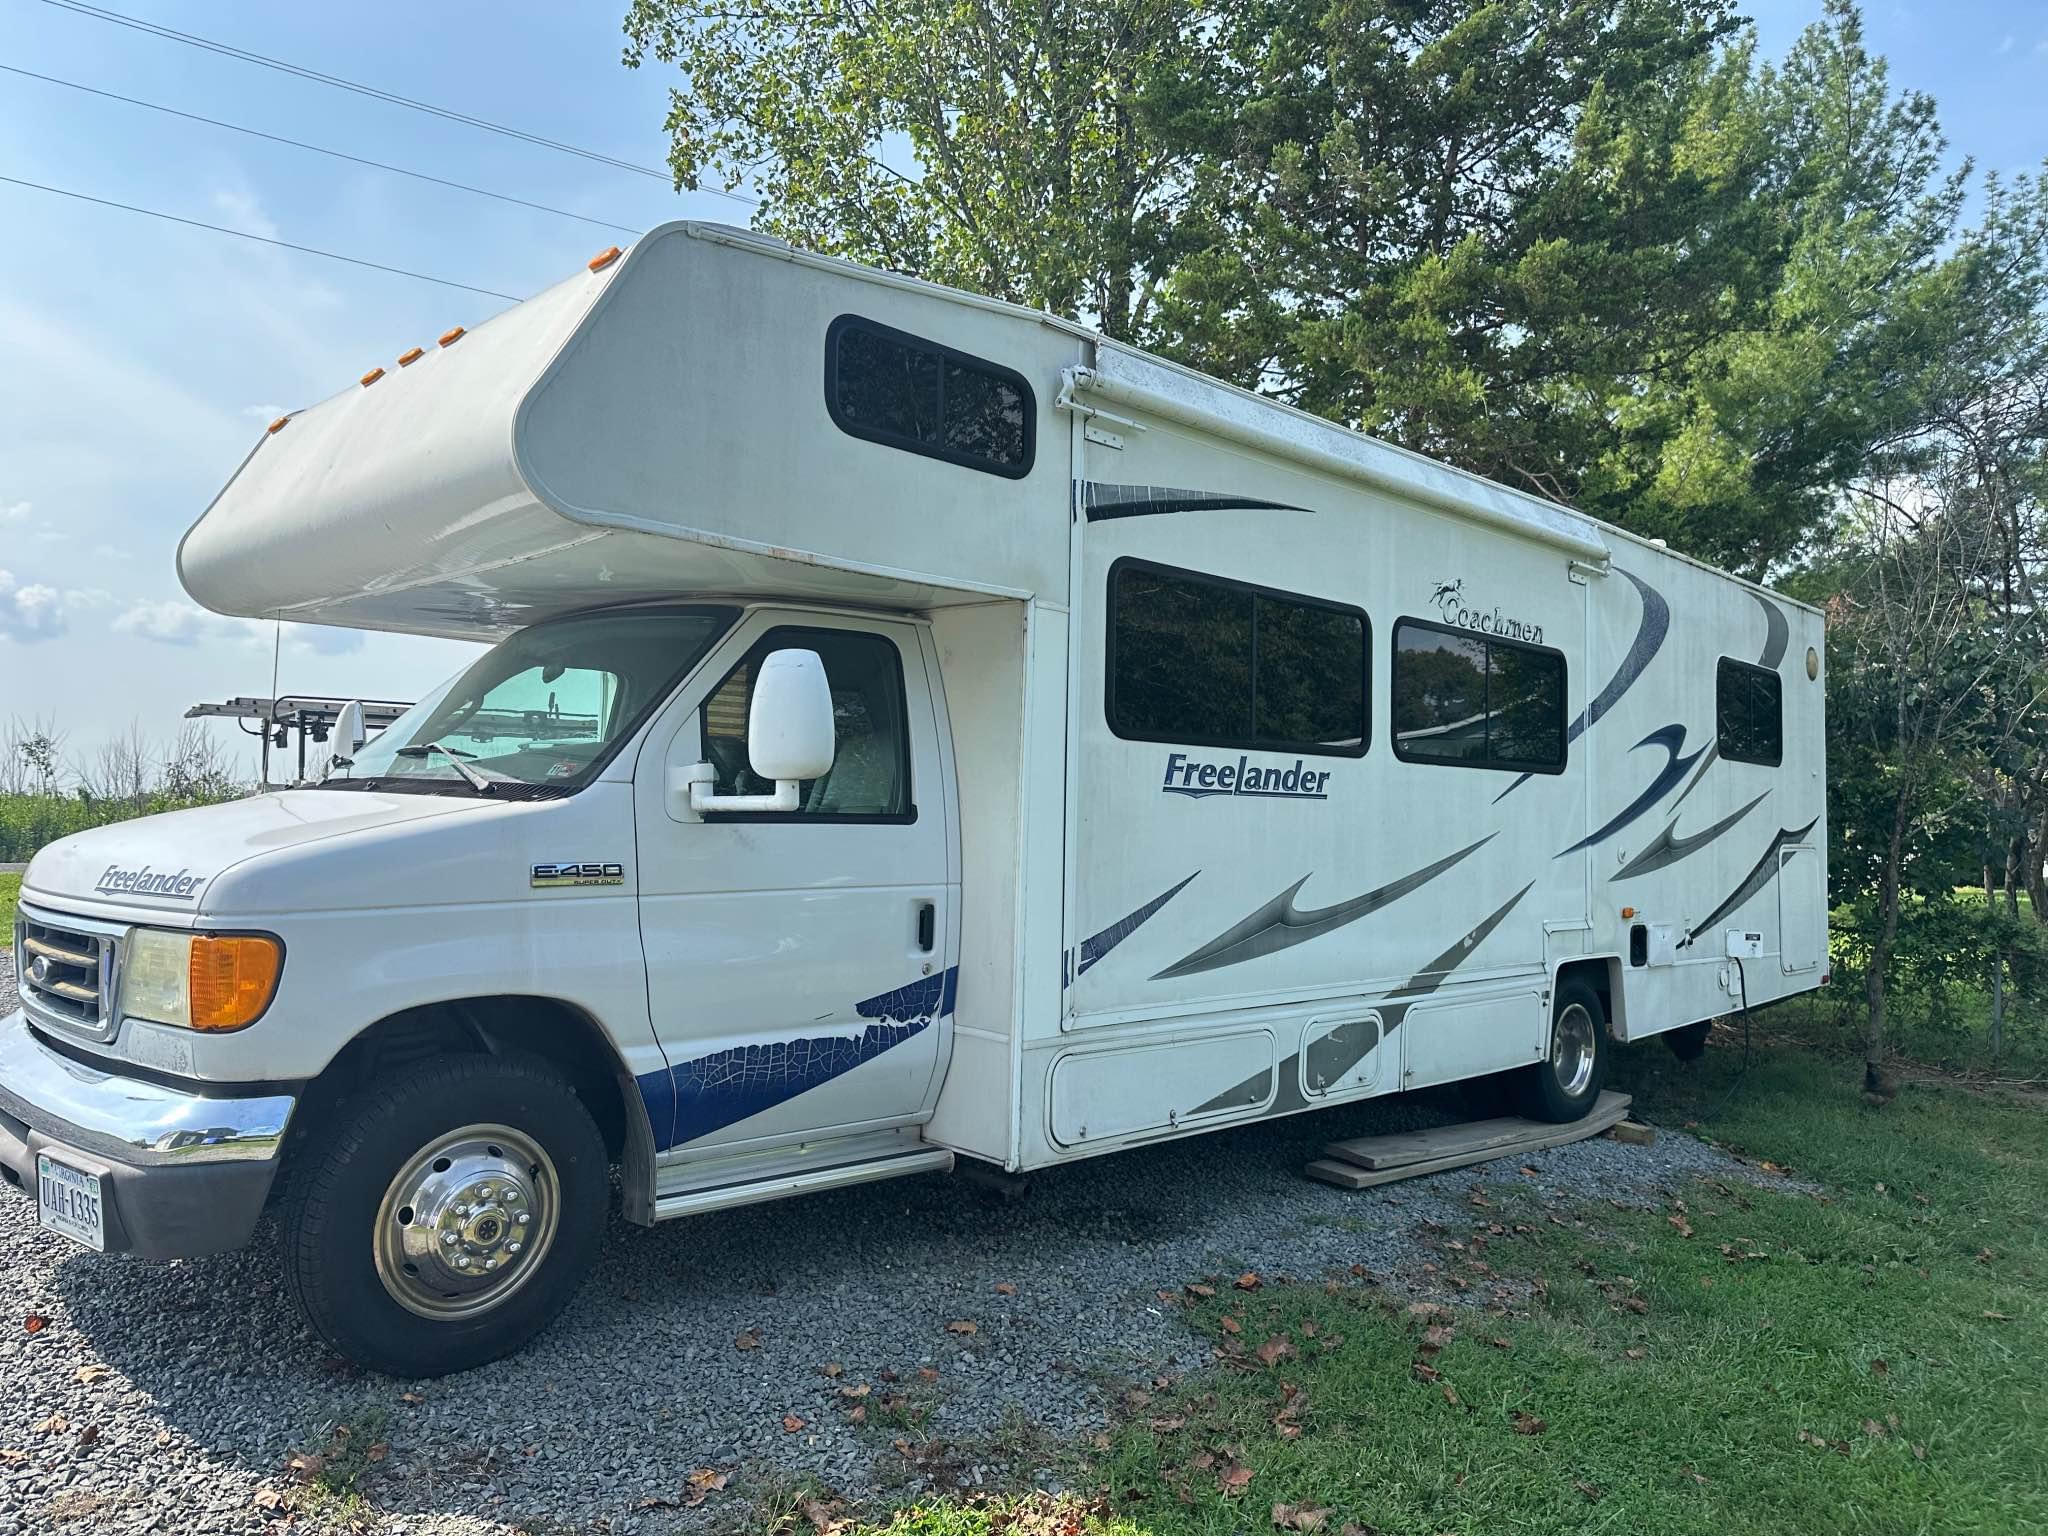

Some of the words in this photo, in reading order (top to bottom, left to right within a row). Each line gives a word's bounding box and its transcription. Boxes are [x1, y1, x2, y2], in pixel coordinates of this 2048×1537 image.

[1443, 598, 1543, 644] Coachmen
[1164, 753, 1331, 796] Freelander
[97, 864, 206, 895] Freelander
[533, 863, 623, 878] E-450
[42, 1176, 98, 1228] UAH-1335
